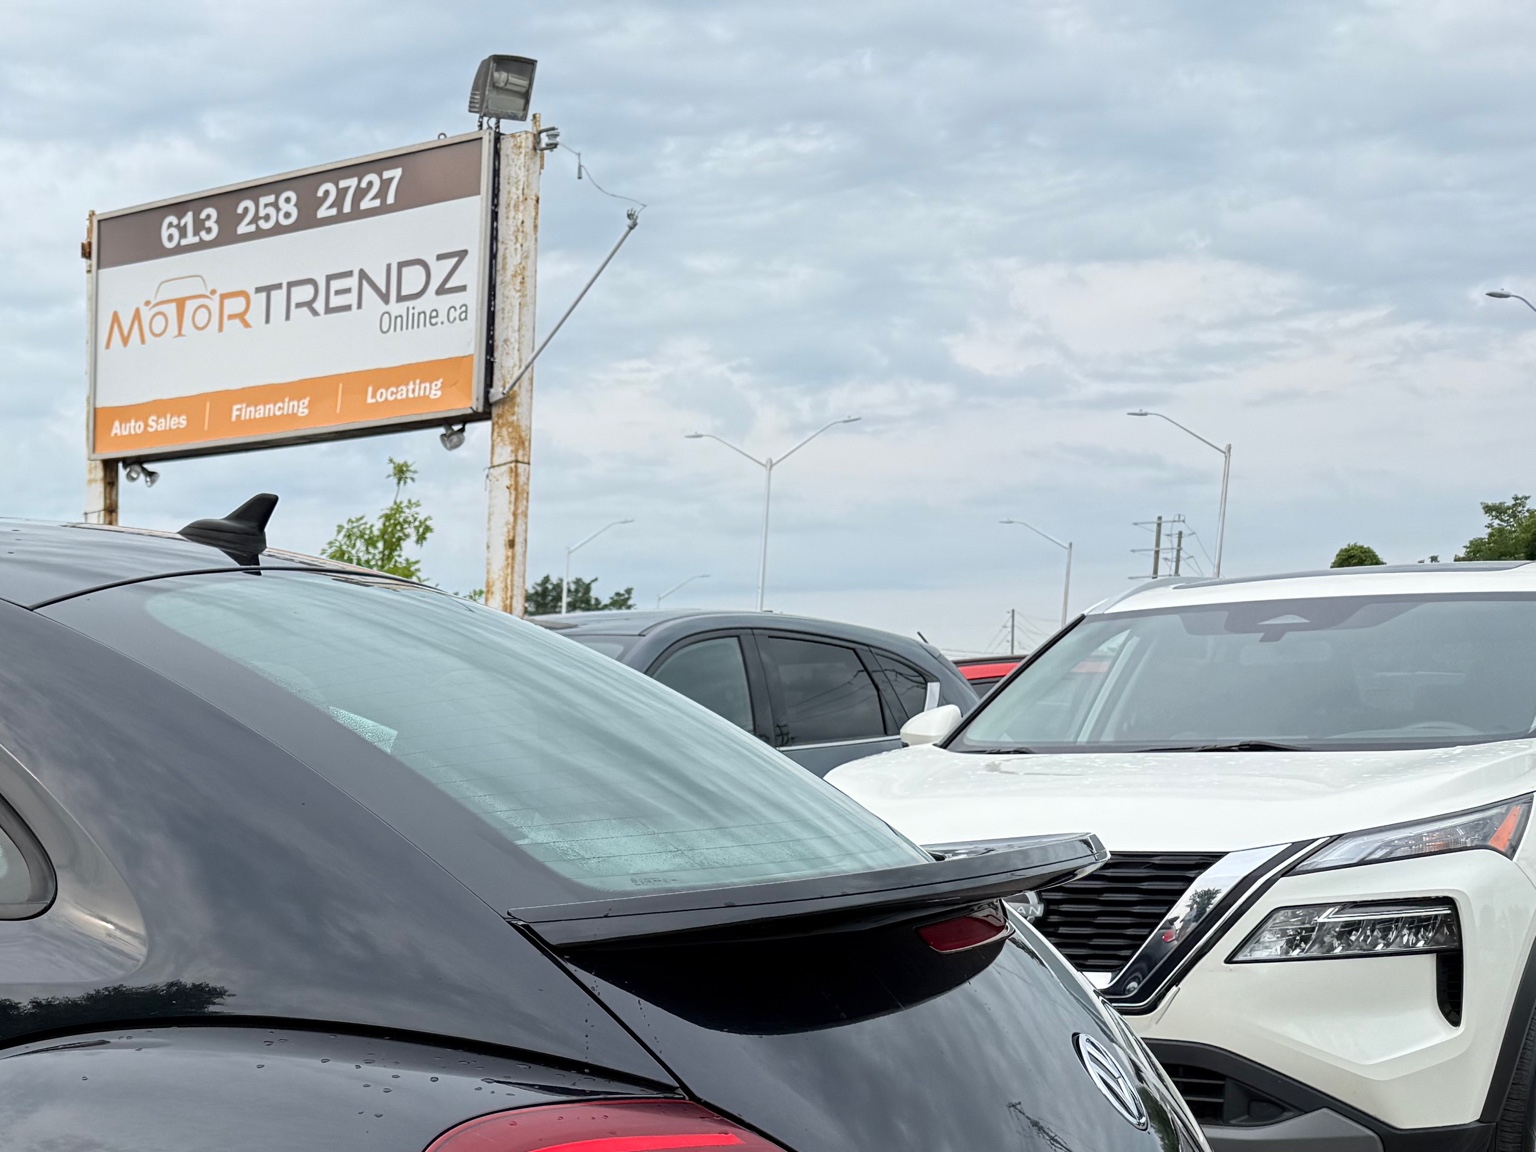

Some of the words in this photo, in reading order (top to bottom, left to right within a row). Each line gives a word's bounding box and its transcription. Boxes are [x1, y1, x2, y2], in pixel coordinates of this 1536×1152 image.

[161, 207, 219, 249] 613
[236, 190, 299, 236] 258
[316, 167, 403, 219] 2727
[379, 302, 468, 335] Online.ca
[366, 378, 443, 404] Locating
[231, 396, 310, 423] Financing
[111, 417, 144, 437] Auto
[147, 414, 187, 433] Sales
